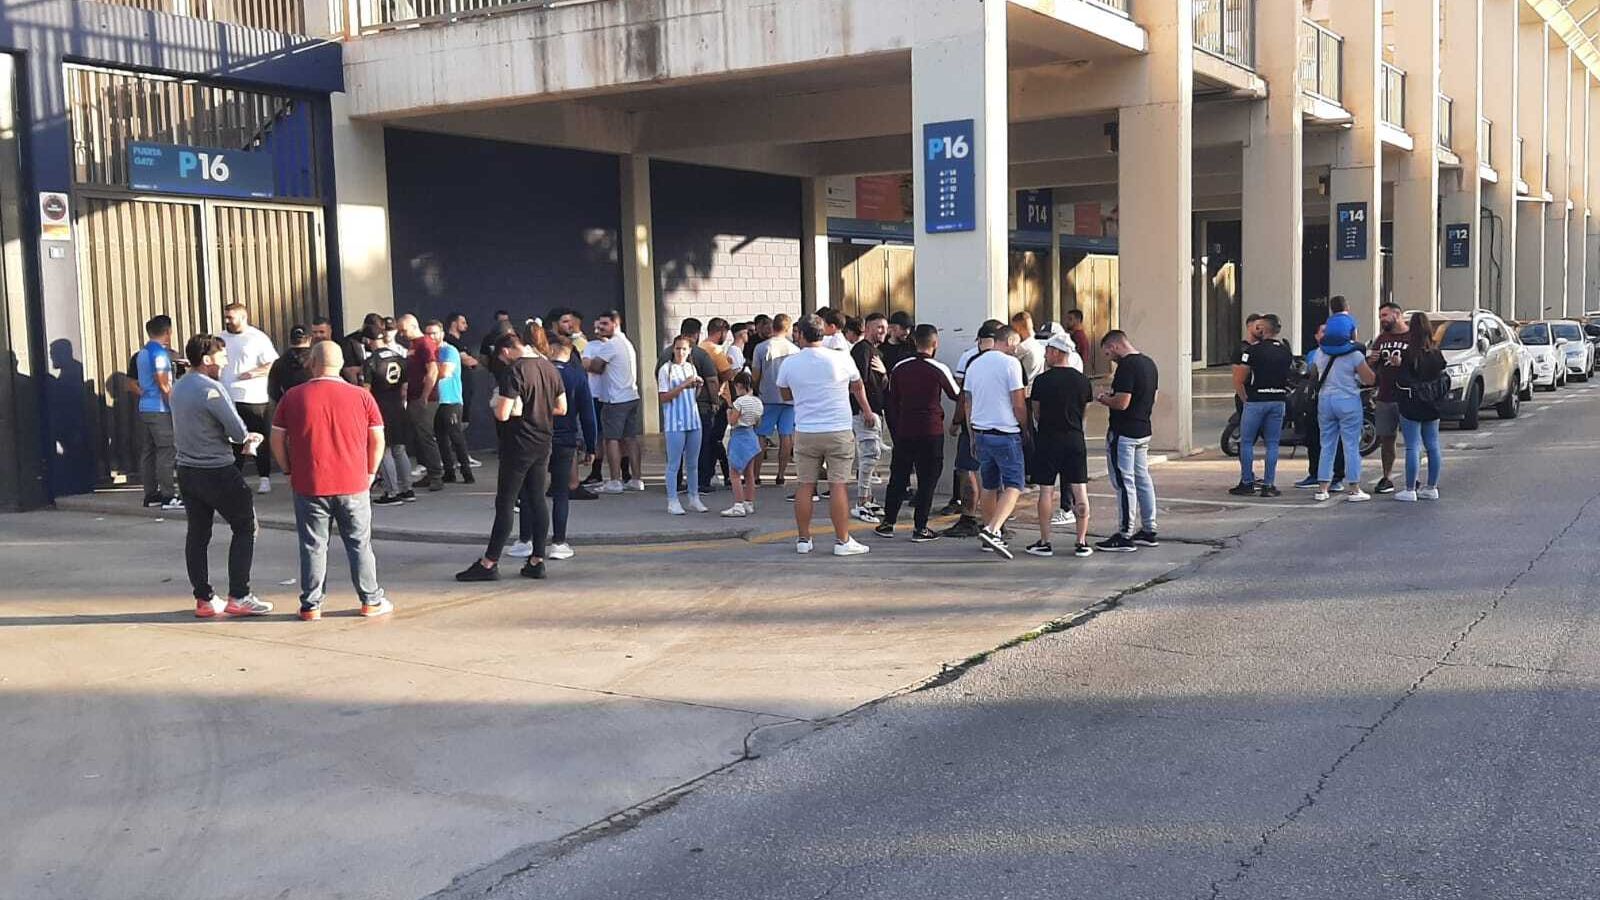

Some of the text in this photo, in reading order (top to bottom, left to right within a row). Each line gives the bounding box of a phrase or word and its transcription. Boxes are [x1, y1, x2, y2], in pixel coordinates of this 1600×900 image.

[928, 135, 969, 160] P16
[178, 151, 230, 182] P16
[1028, 205, 1048, 223] P14
[1340, 210, 1364, 222] P14
[1448, 229, 1468, 239] P12
